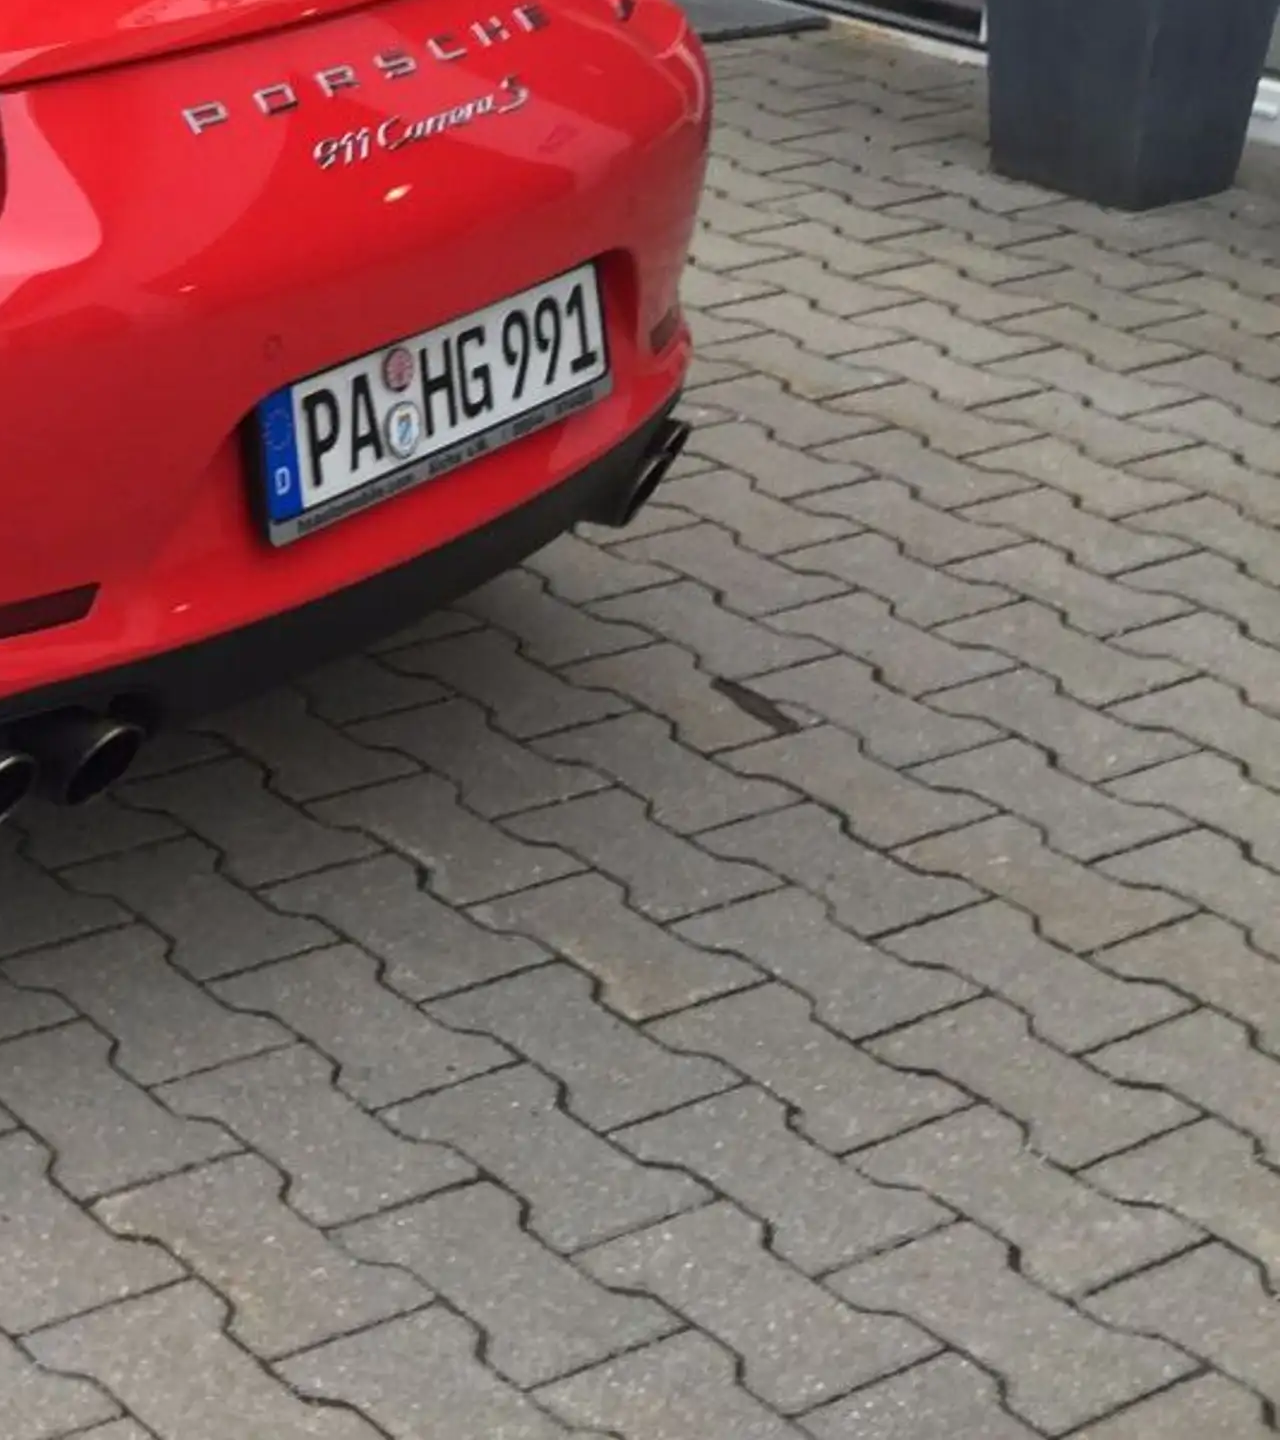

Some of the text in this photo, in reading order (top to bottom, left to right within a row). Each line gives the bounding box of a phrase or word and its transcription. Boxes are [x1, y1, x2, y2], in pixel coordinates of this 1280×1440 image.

[182, 3, 550, 135] PORSCHE
[311, 74, 531, 170] 911 Carrera S
[301, 283, 598, 487] PA HG 991
[274, 467, 291, 495] D
